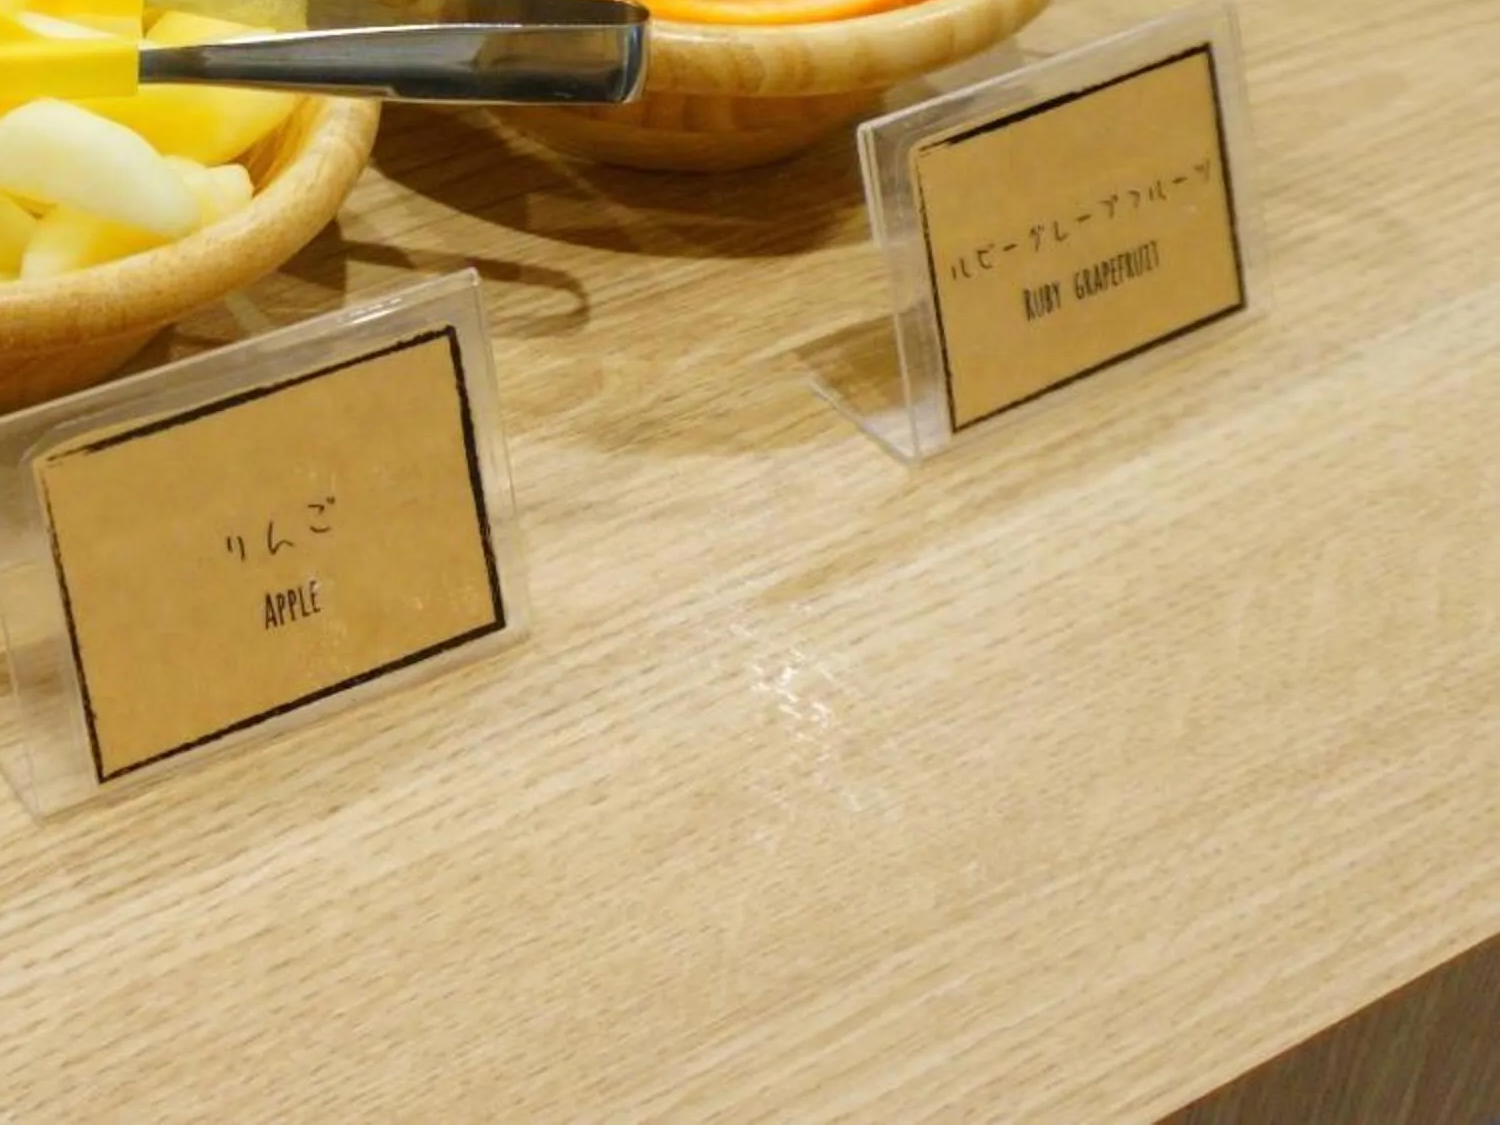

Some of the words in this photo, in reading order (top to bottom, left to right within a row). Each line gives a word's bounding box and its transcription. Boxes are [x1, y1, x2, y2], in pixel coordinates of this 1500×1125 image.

[950, 159, 1211, 281] ルビーグレープフルーツ
[1022, 282, 1062, 322] RUBY
[1073, 240, 1160, 300] GRAPEFRUIT
[226, 496, 336, 563] りんご
[265, 579, 321, 630] APPLE
